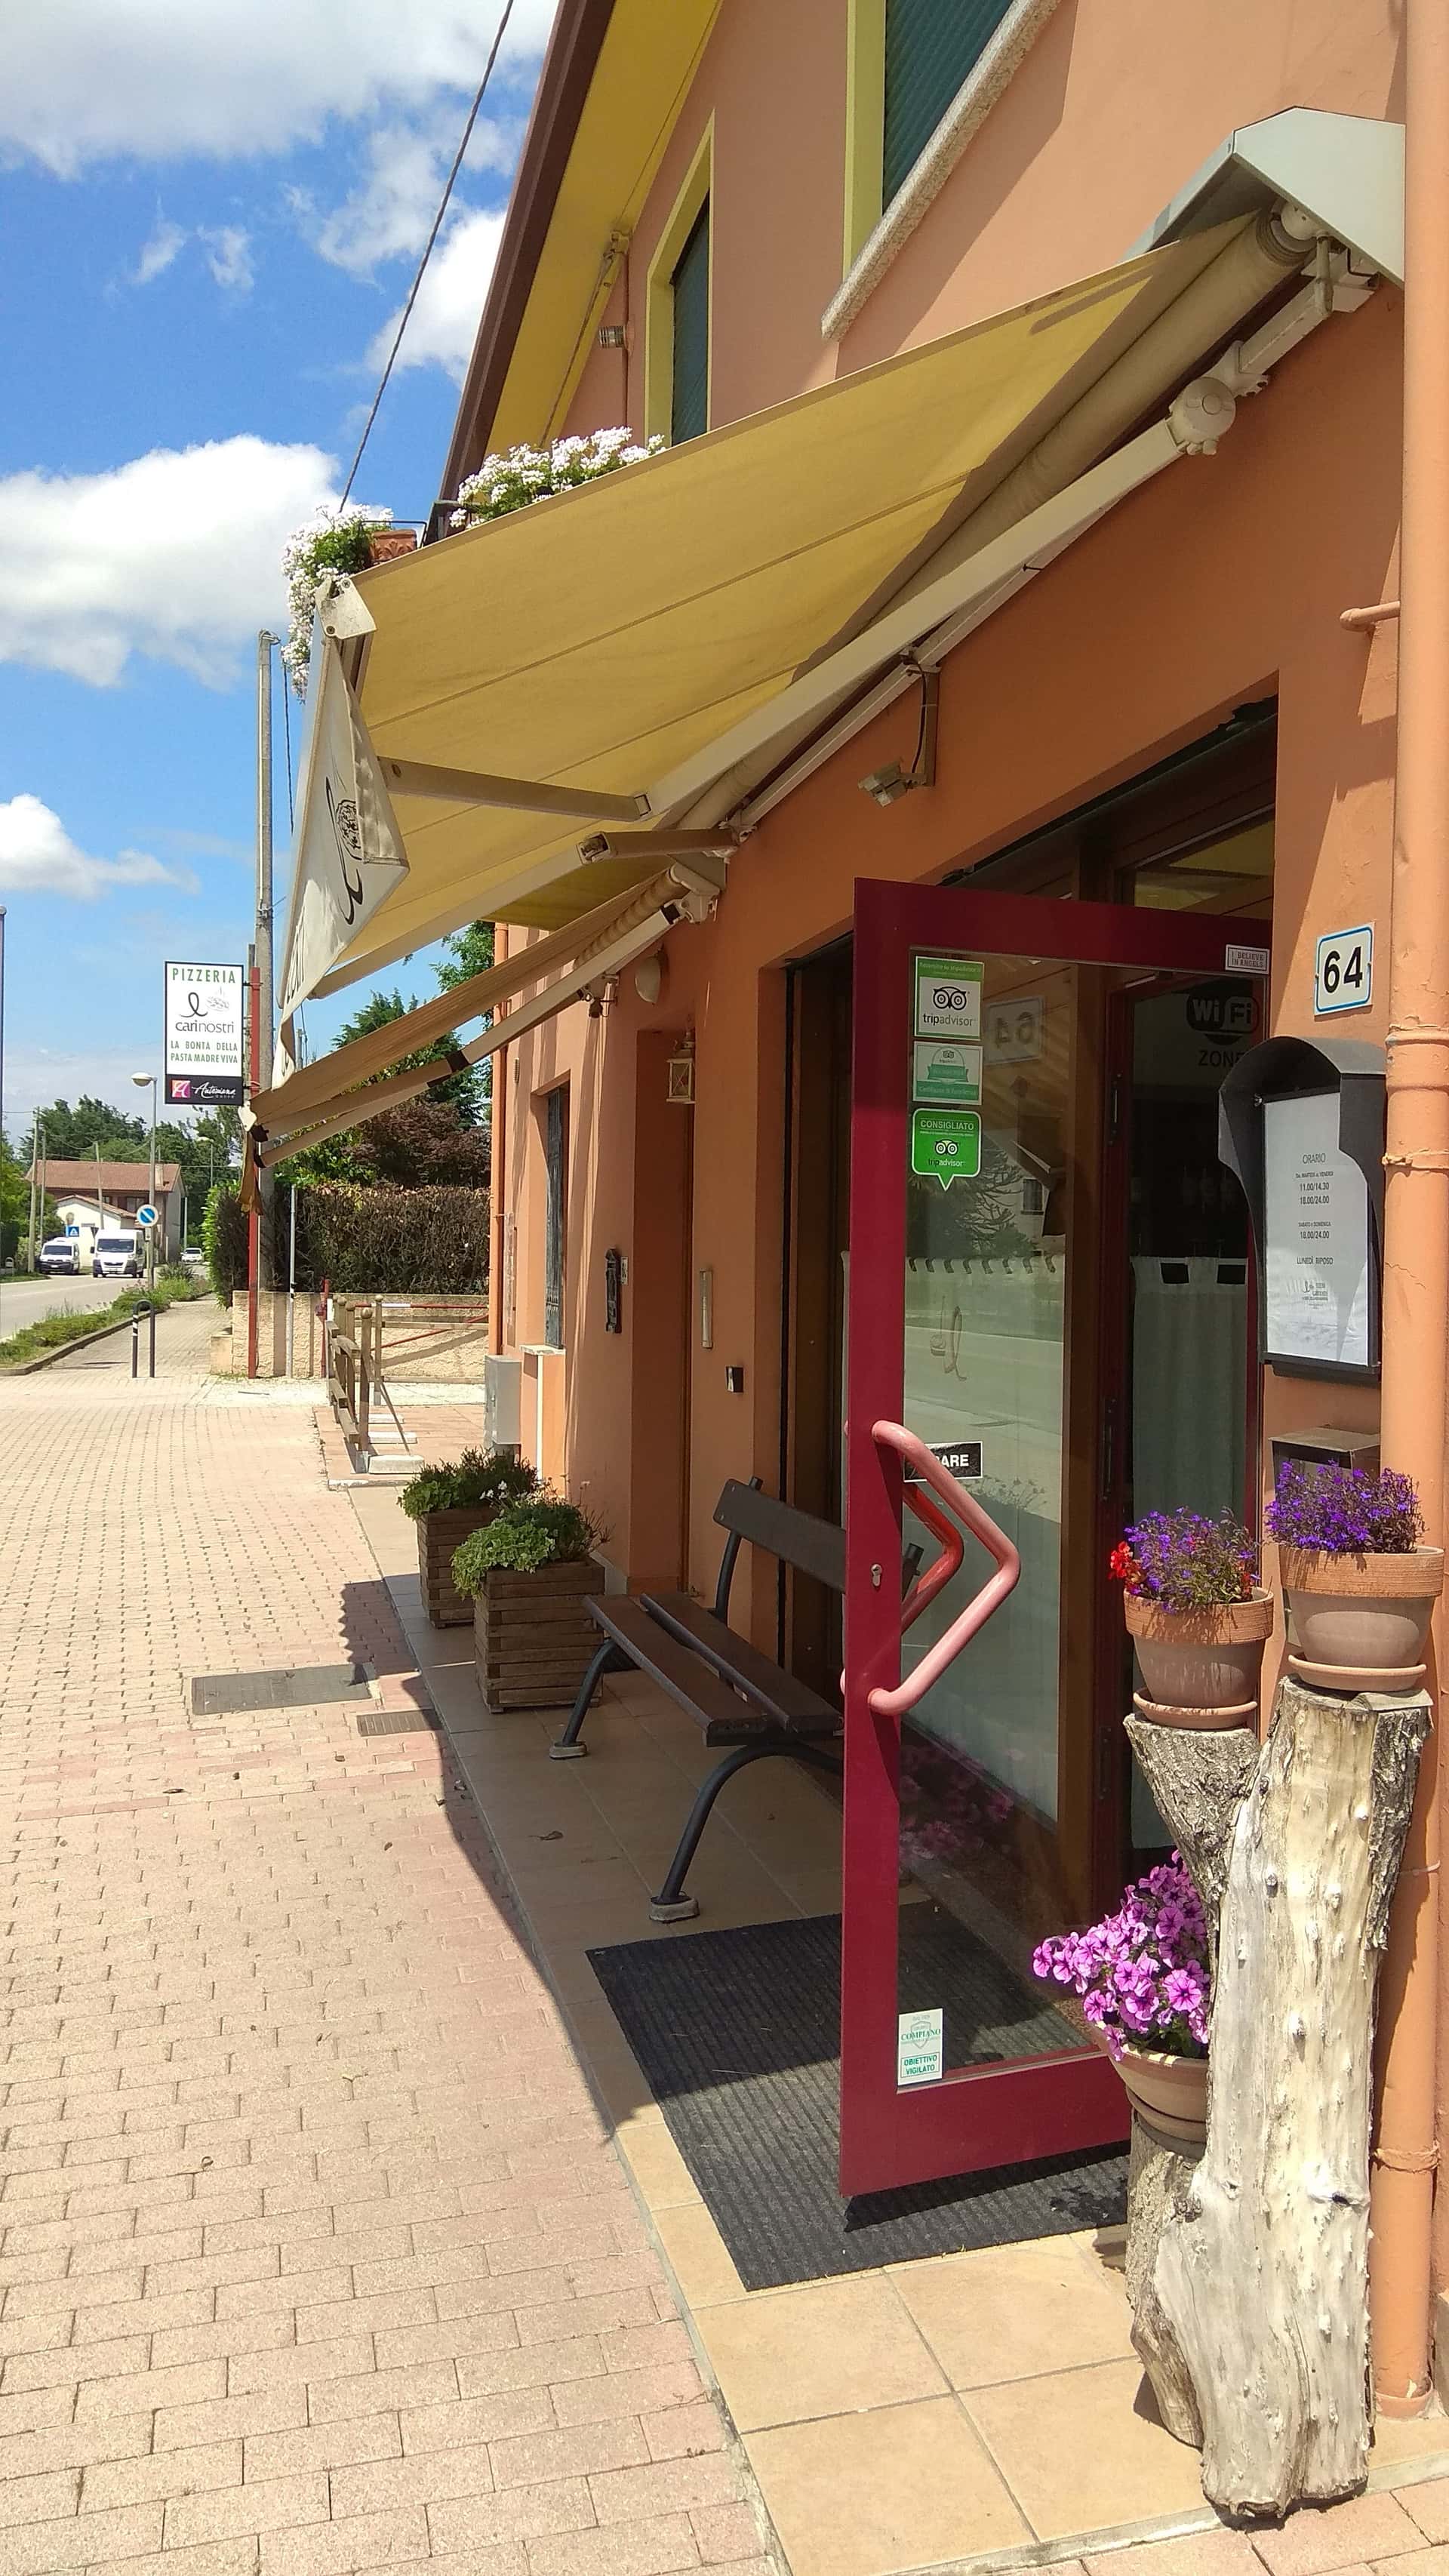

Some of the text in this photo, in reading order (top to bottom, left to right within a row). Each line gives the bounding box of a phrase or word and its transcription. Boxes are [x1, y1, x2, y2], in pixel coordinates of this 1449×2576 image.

[1238, 951, 1264, 960] BELIEVE
[1240, 959, 1263, 968] ANGELS
[1323, 945, 1363, 994] 64
[172, 968, 236, 983] PIZZERIA
[922, 1013, 973, 1026] tripadvisor
[175, 1020, 234, 1033] carinostri
[171, 1040, 180, 1049] LA
[217, 1042, 238, 1051] DELLA
[171, 1053, 238, 1063] PASTA MADRE VIVA
[920, 1120, 974, 1131] CONSIGLIATO
[928, 1159, 964, 1167] tripadvisor
[1303, 1153, 1326, 1164] ORARIO
[1300, 1182, 1330, 1191] 11.00/14.30
[1300, 1195, 1330, 1205] 18.00/24.00
[1300, 1230, 1330, 1239] 18.00/24.00
[904, 2054, 937, 2066] OBIETTIVO
[906, 2064, 935, 2075] VIGILATO
